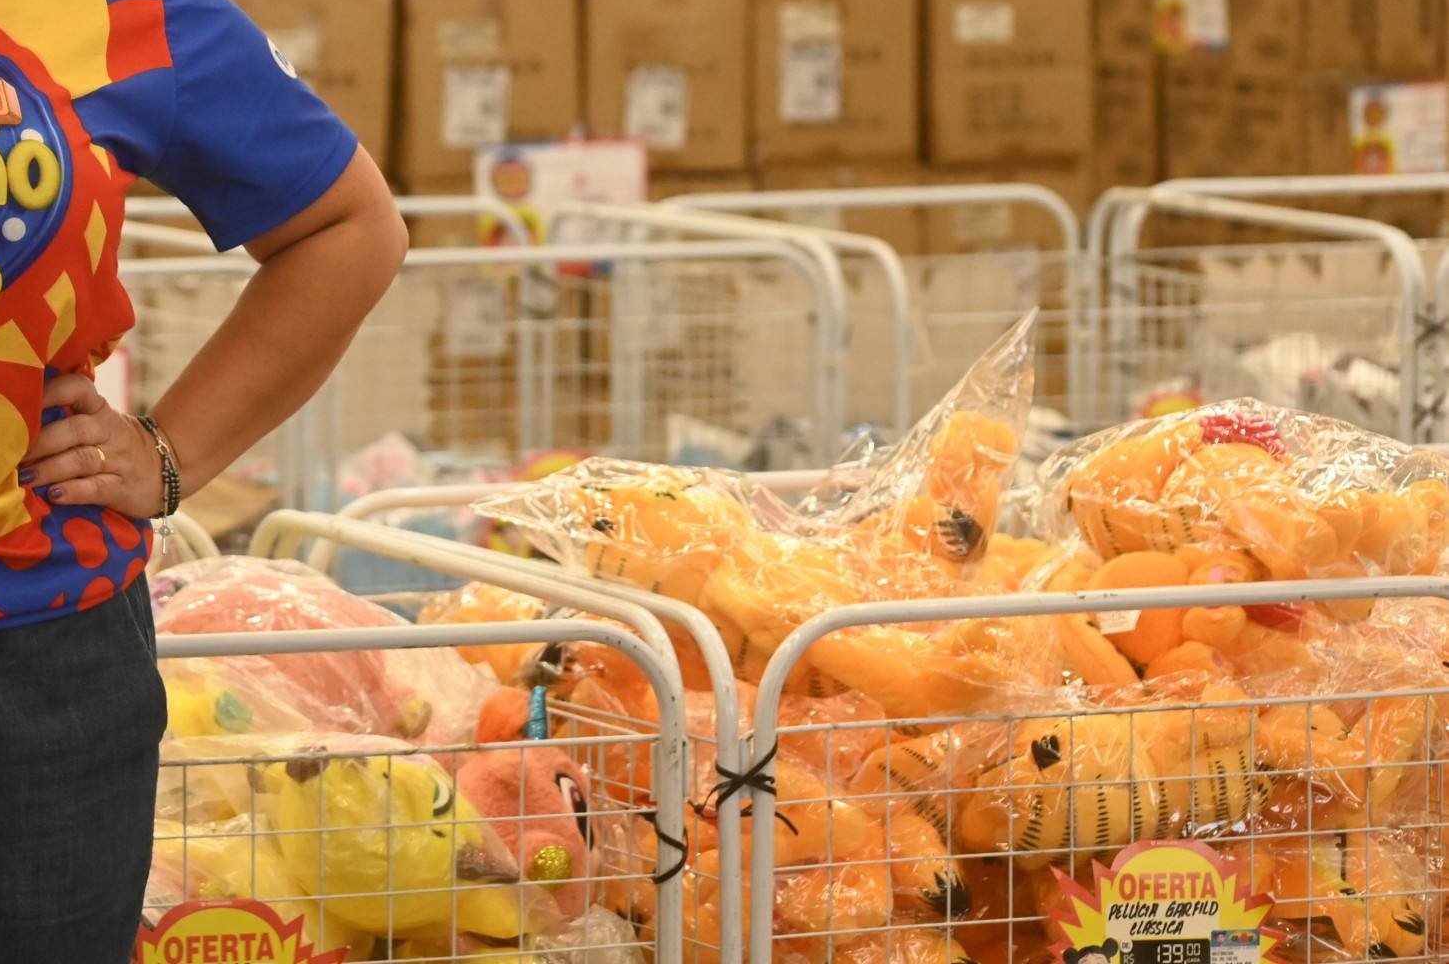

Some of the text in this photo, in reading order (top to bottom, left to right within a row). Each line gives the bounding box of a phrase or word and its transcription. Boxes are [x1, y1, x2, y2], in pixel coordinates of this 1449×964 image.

[1118, 872, 1218, 901] OFERTA
[1165, 900, 1219, 918] GARFILD
[163, 933, 275, 964] OFERTA
